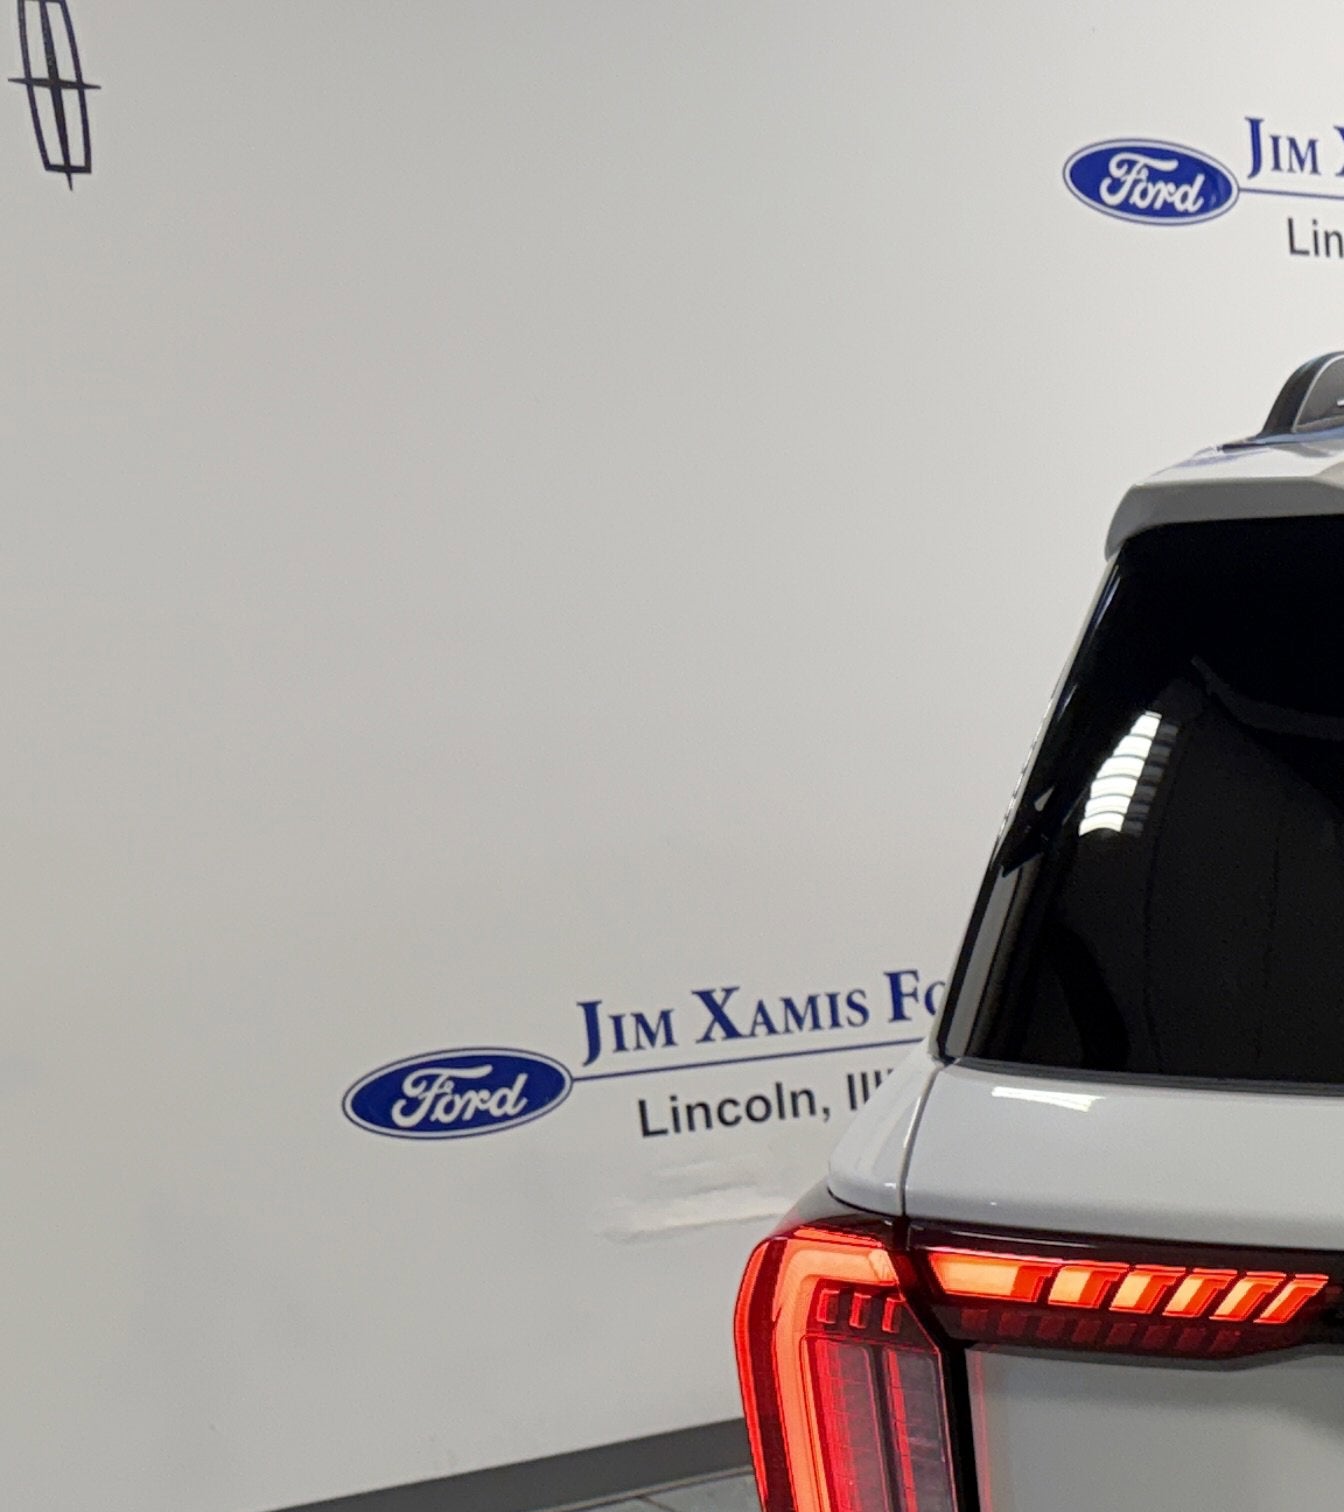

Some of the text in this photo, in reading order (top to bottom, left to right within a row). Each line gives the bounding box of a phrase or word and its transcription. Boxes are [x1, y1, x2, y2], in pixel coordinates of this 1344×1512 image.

[1244, 116, 1321, 180] JIM
[1100, 151, 1204, 213] Ford
[576, 999, 677, 1067] JIM
[691, 986, 871, 1044] XAMIS
[391, 1064, 529, 1127] Ford
[637, 1082, 832, 1139] Lincoln,
